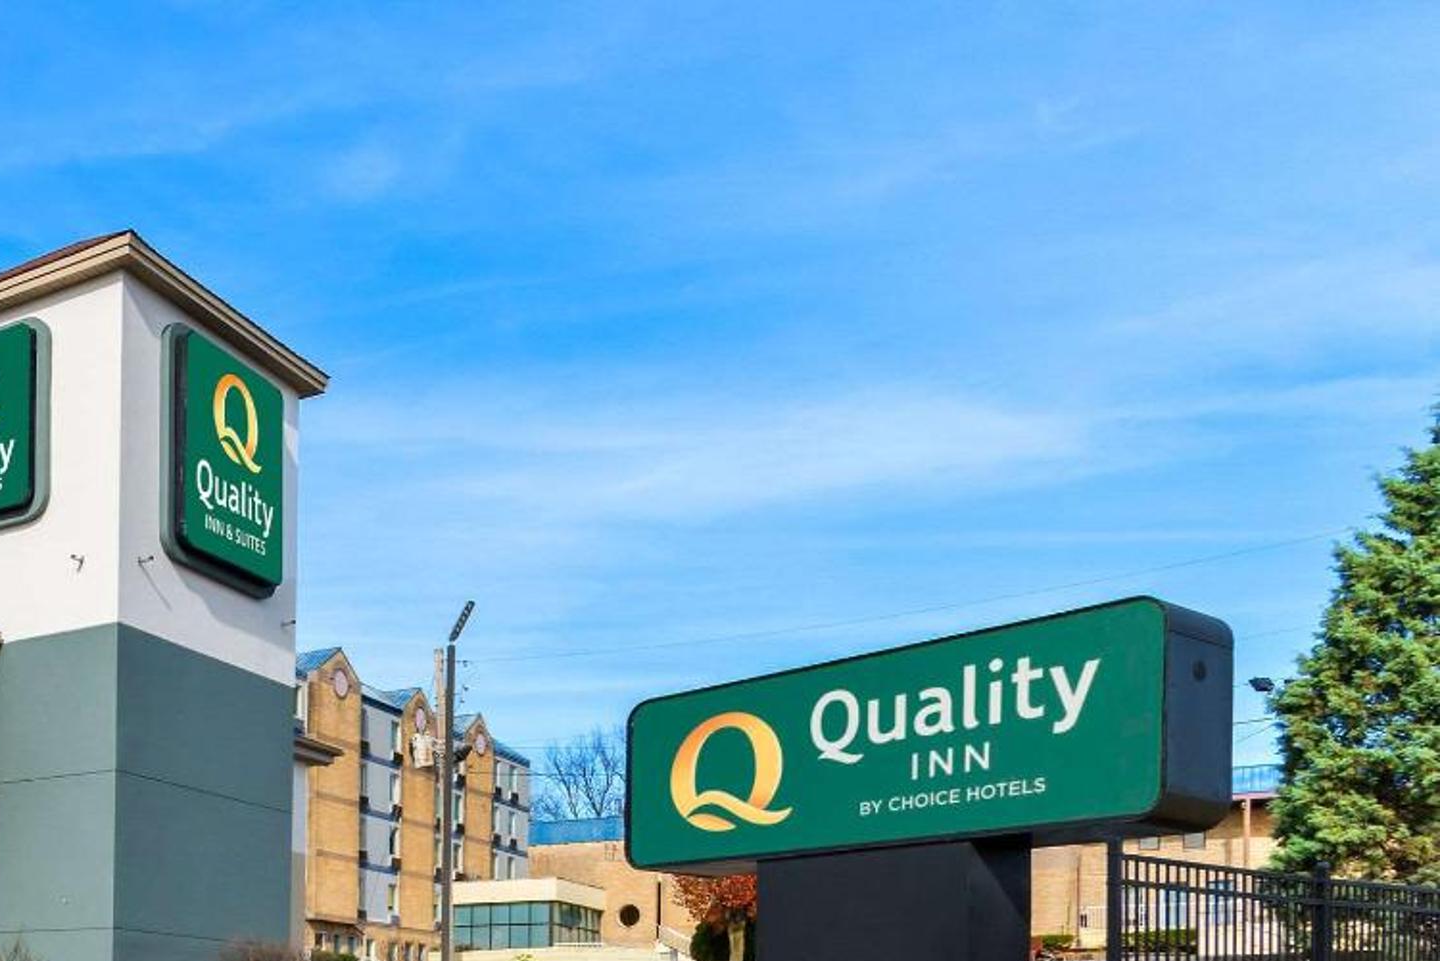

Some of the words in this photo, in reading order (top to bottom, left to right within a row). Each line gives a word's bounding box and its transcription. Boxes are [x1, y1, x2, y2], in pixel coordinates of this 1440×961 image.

[213, 373, 262, 474] Q
[196, 458, 274, 538] Quality
[204, 513, 225, 537] INN
[226, 523, 233, 541] &
[235, 527, 266, 556] SUITES
[810, 656, 1101, 765] Quality
[670, 711, 793, 832] Q
[860, 799, 883, 816] BY
[888, 788, 960, 811] CHOICE
[966, 777, 1047, 802] HOTELS
[911, 741, 991, 781] INN
